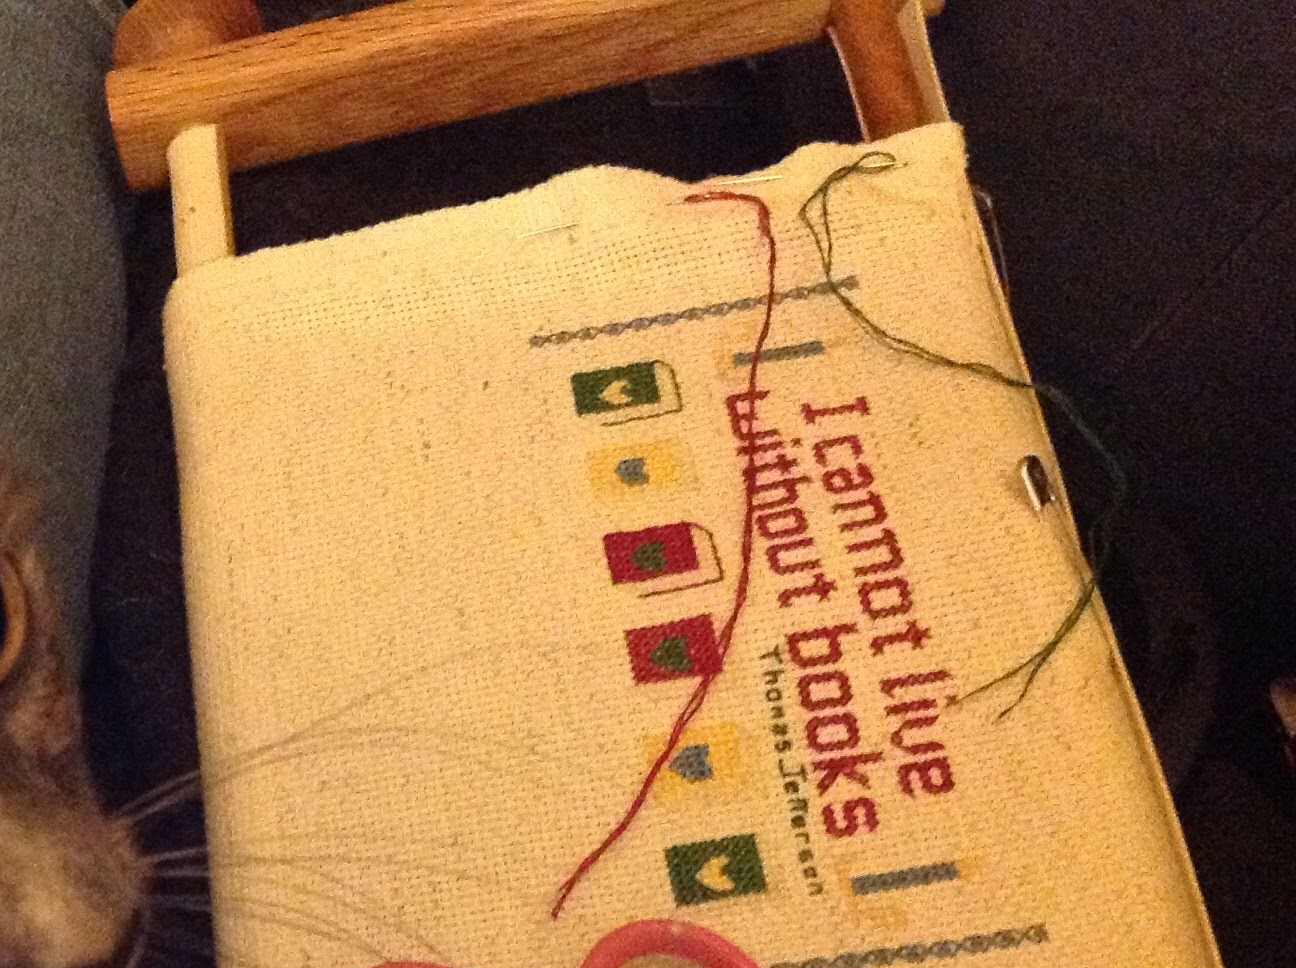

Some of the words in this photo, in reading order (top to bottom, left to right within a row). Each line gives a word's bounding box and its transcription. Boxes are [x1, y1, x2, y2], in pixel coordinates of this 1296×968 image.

[801, 396, 871, 424] I
[725, 389, 838, 609] without
[785, 622, 884, 839] books
[812, 434, 932, 657] cannot
[759, 644, 793, 753] Thomas
[778, 758, 824, 897] Jefferson
[879, 669, 957, 798] live
